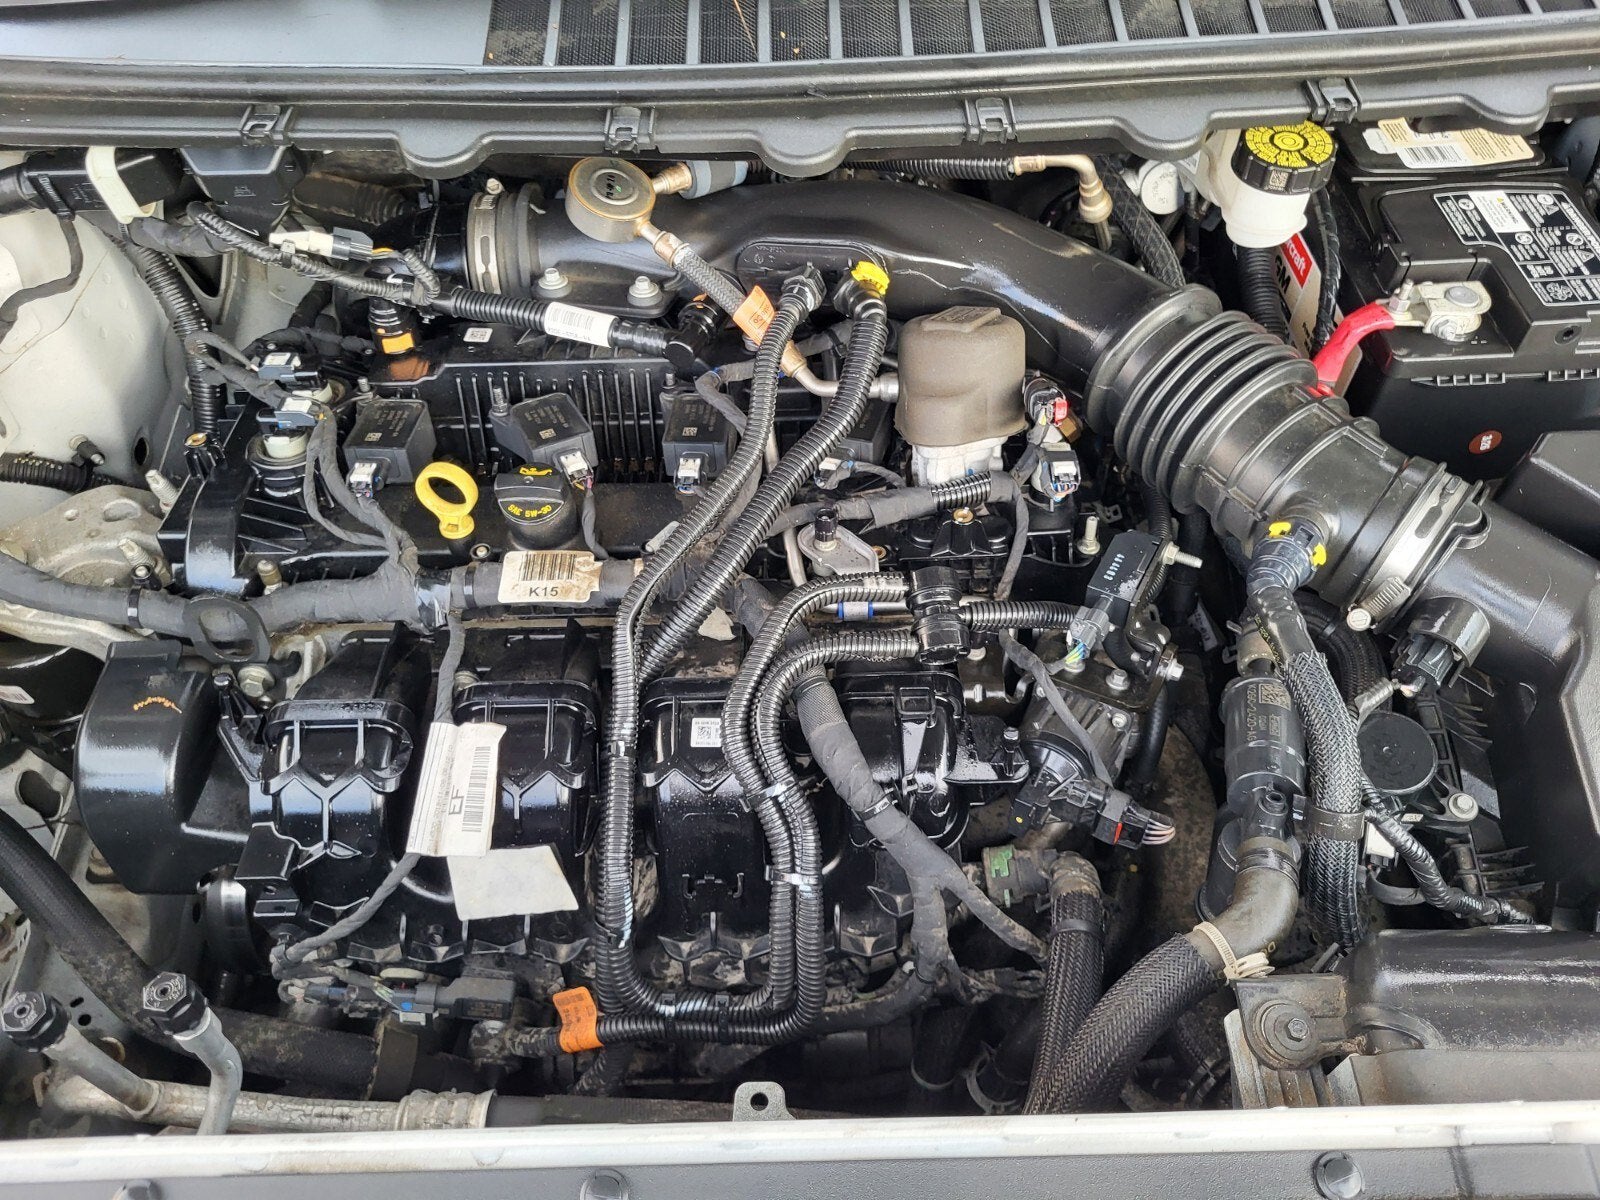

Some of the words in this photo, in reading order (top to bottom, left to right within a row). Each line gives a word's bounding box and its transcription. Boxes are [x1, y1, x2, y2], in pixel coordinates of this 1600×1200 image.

[507, 504, 523, 516] SAE
[524, 504, 552, 518] 5W-30
[529, 586, 558, 597] K15
